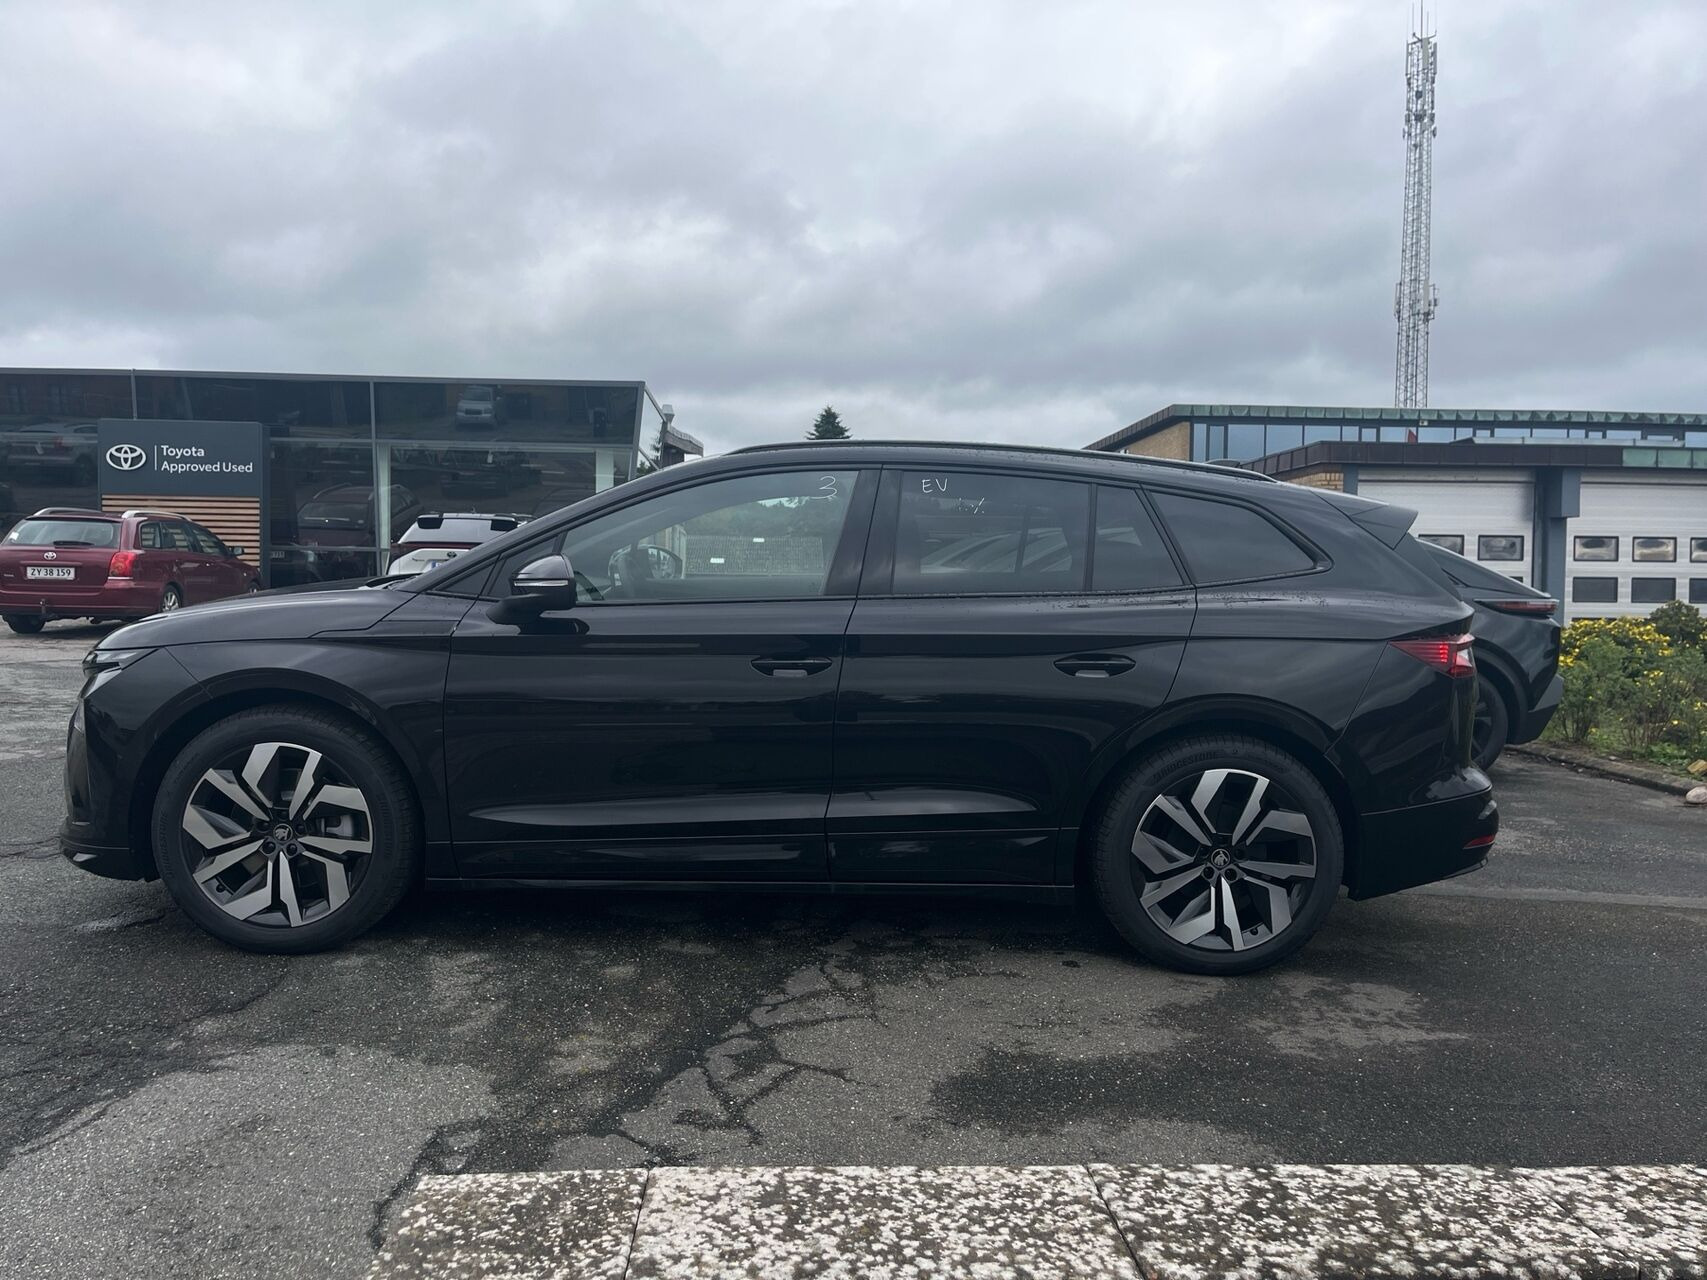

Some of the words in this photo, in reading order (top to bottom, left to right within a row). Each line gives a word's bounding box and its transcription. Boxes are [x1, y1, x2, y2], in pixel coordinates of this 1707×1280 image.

[160, 445, 205, 459] Toyota
[161, 461, 220, 474] Approved
[222, 462, 253, 473] Used
[811, 475, 838, 499] 3
[921, 478, 948, 493] EV
[30, 568, 42, 576] ZY
[43, 568, 54, 577] 38
[56, 568, 72, 577] 159
